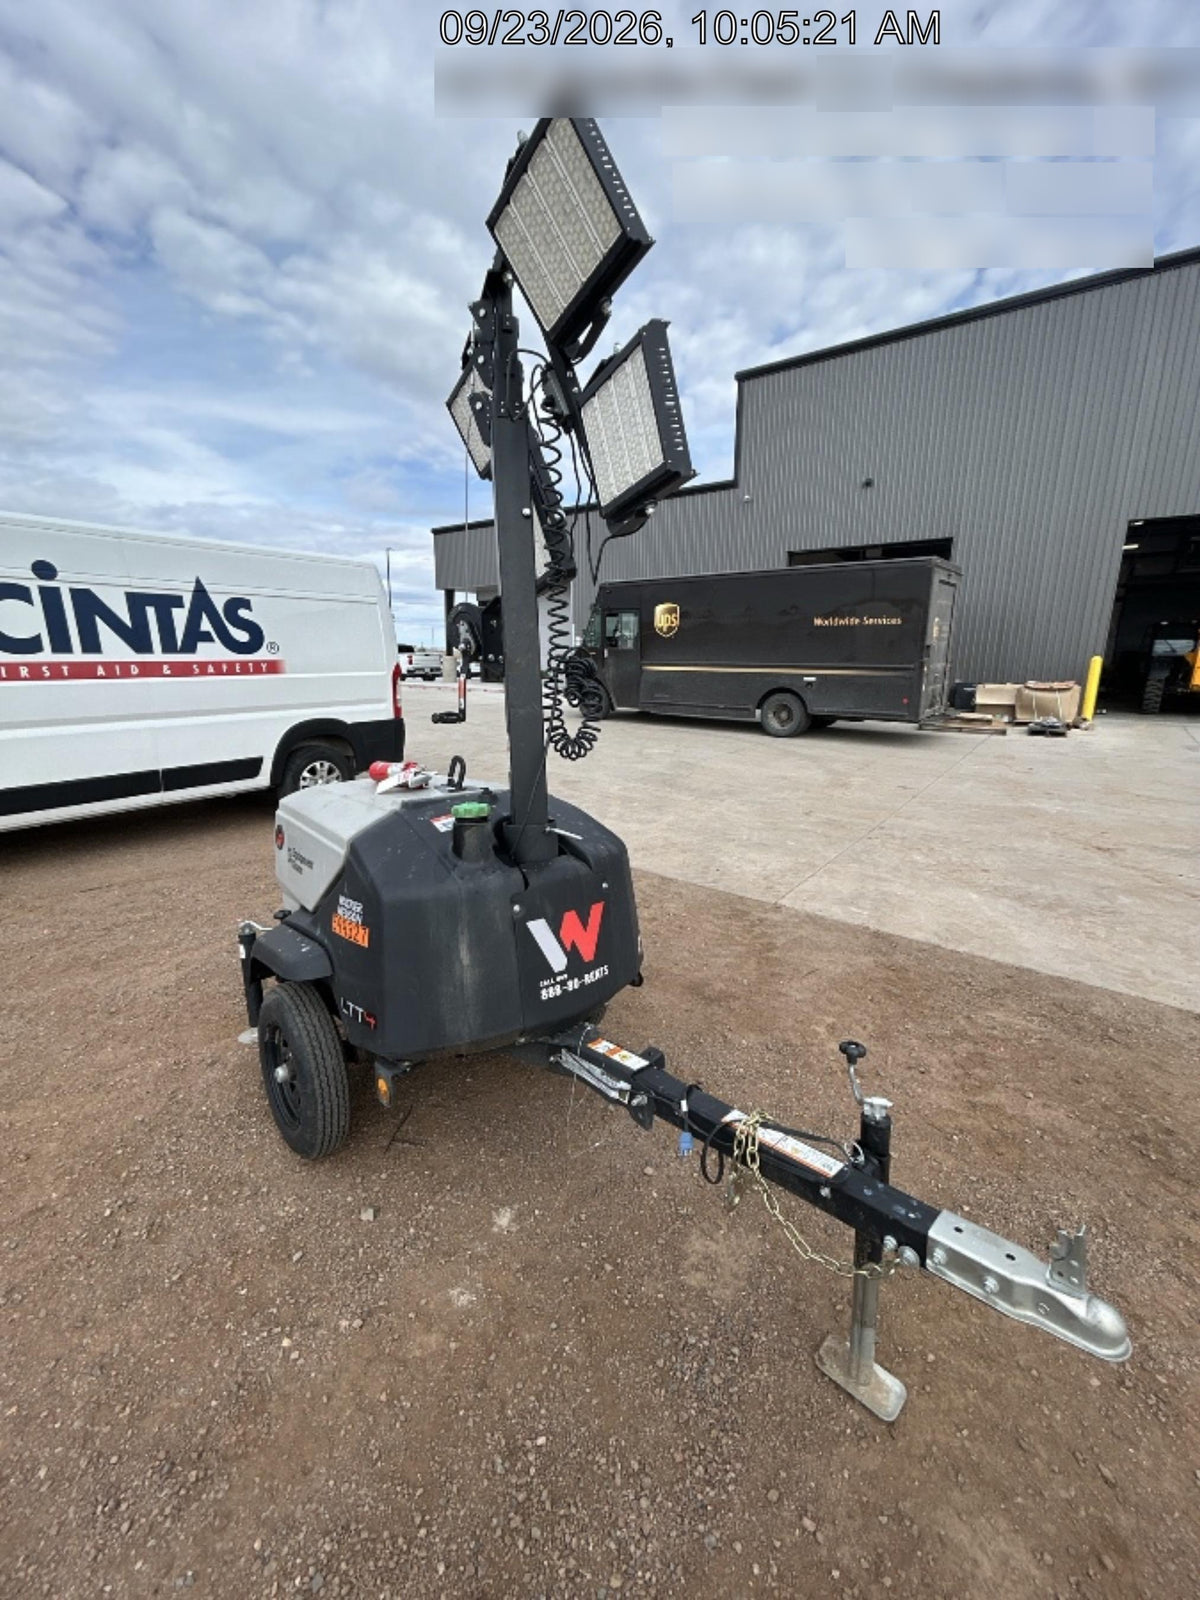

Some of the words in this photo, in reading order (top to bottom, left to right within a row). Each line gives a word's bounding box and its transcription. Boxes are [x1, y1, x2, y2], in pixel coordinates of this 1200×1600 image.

[813, 615, 860, 627] Worldwide
[861, 614, 902, 626] Services
[0, 665, 70, 678] IRST
[97, 665, 140, 677] AID
[162, 663, 172, 676] &
[192, 662, 268, 674] SAFETY
